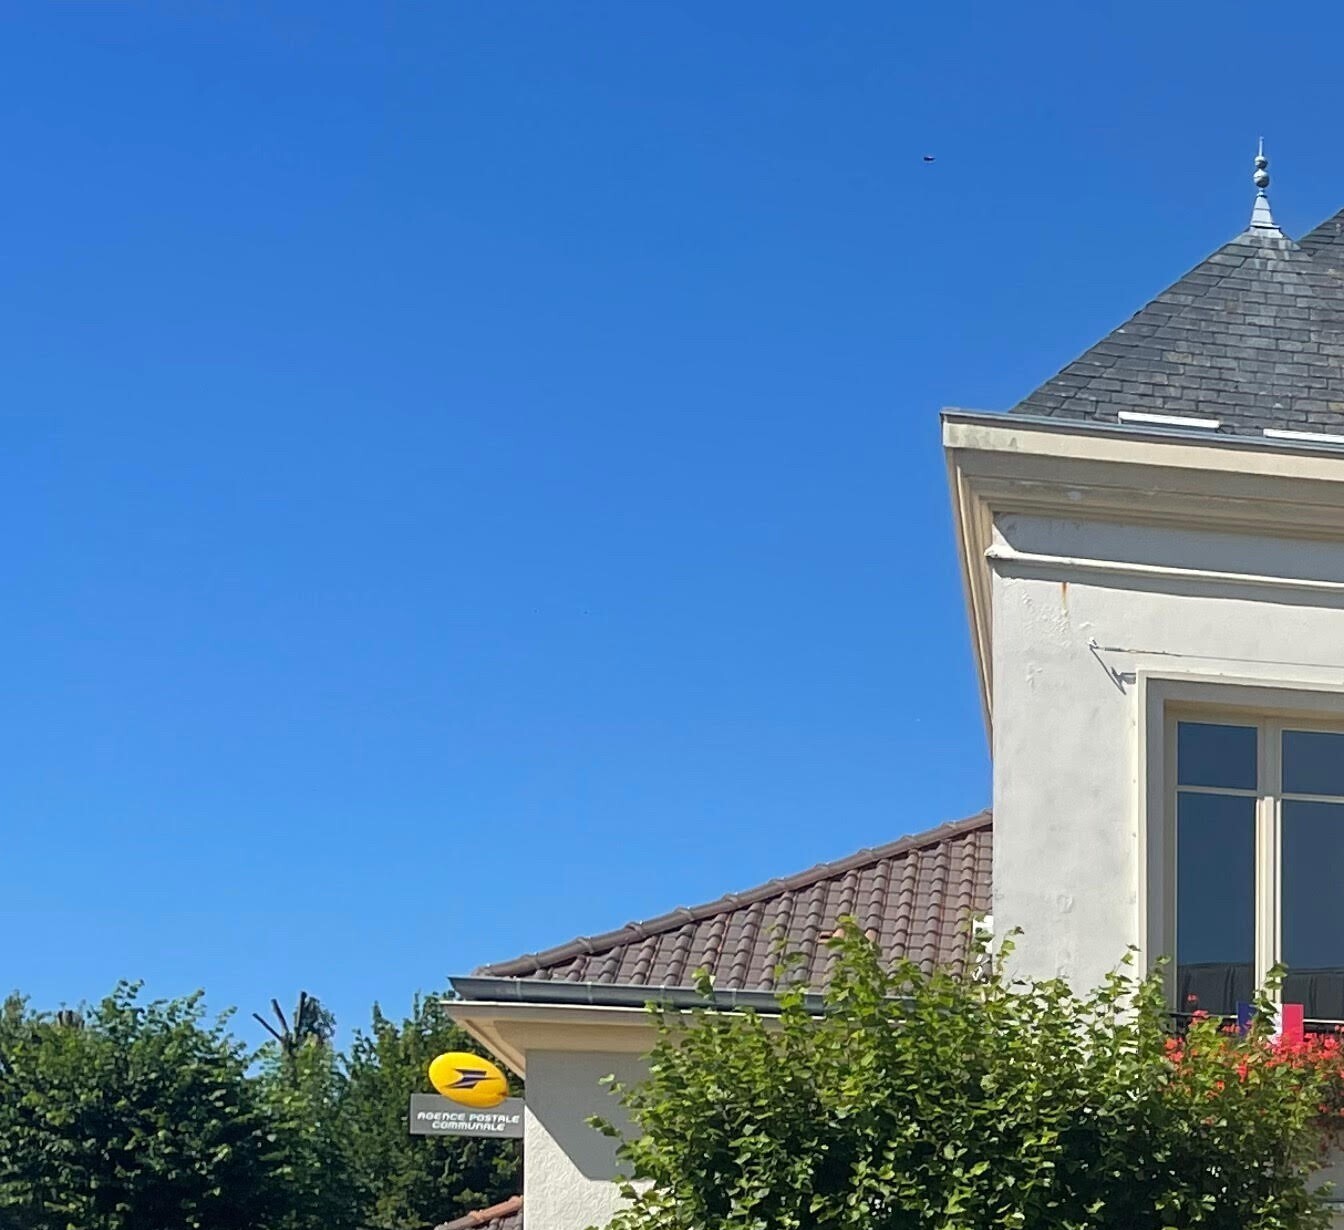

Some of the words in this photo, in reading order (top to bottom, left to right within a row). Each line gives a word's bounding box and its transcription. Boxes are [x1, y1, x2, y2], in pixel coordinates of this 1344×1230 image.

[417, 1112, 465, 1121] AGENCE
[469, 1113, 520, 1124] POSTALE
[432, 1120, 505, 1131] COMMUNALE
